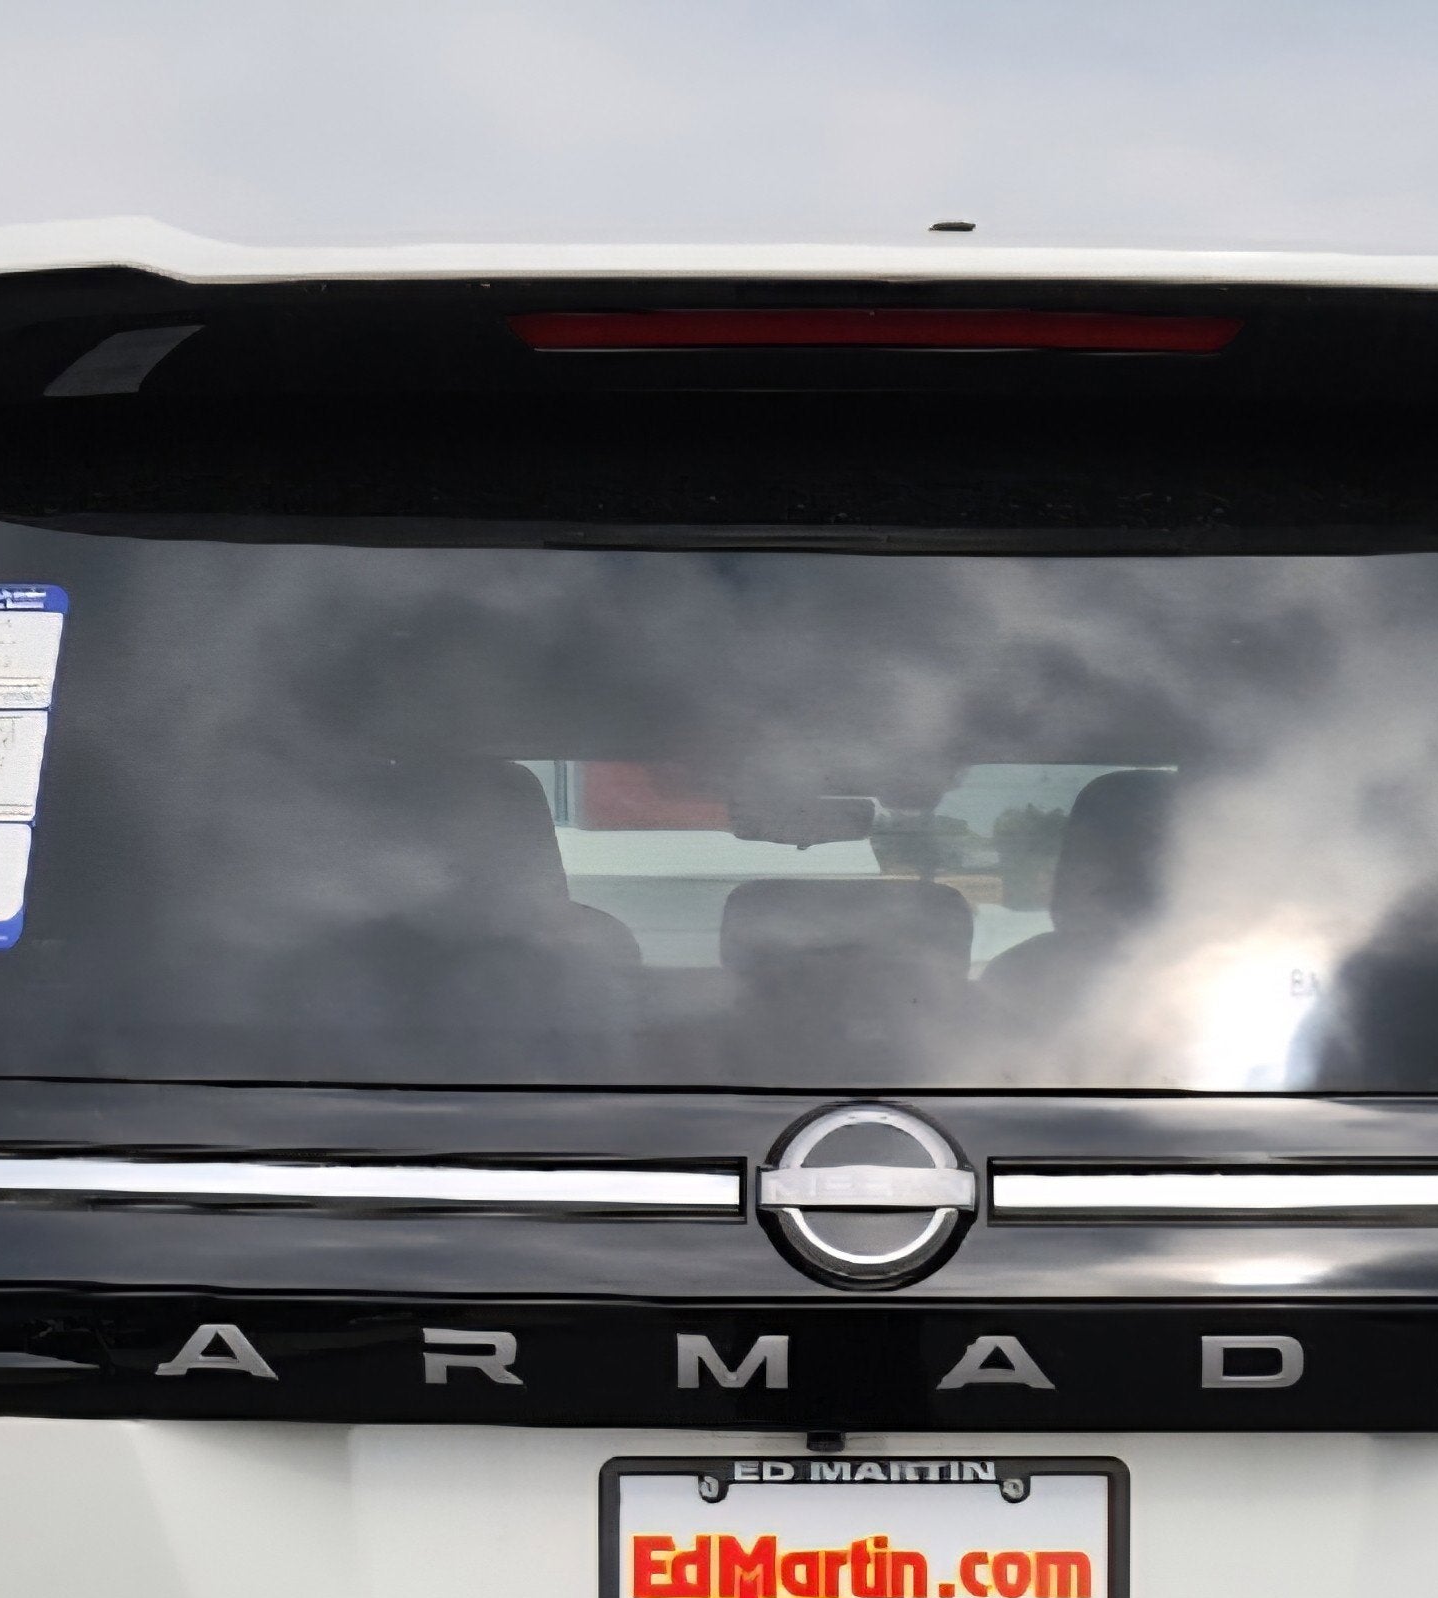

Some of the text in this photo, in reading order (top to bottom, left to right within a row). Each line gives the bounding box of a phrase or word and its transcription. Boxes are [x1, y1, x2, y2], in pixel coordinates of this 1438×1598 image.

[733, 1461, 997, 1483] ED MARTIN
[633, 1535, 1092, 1598] EdMartin.com
